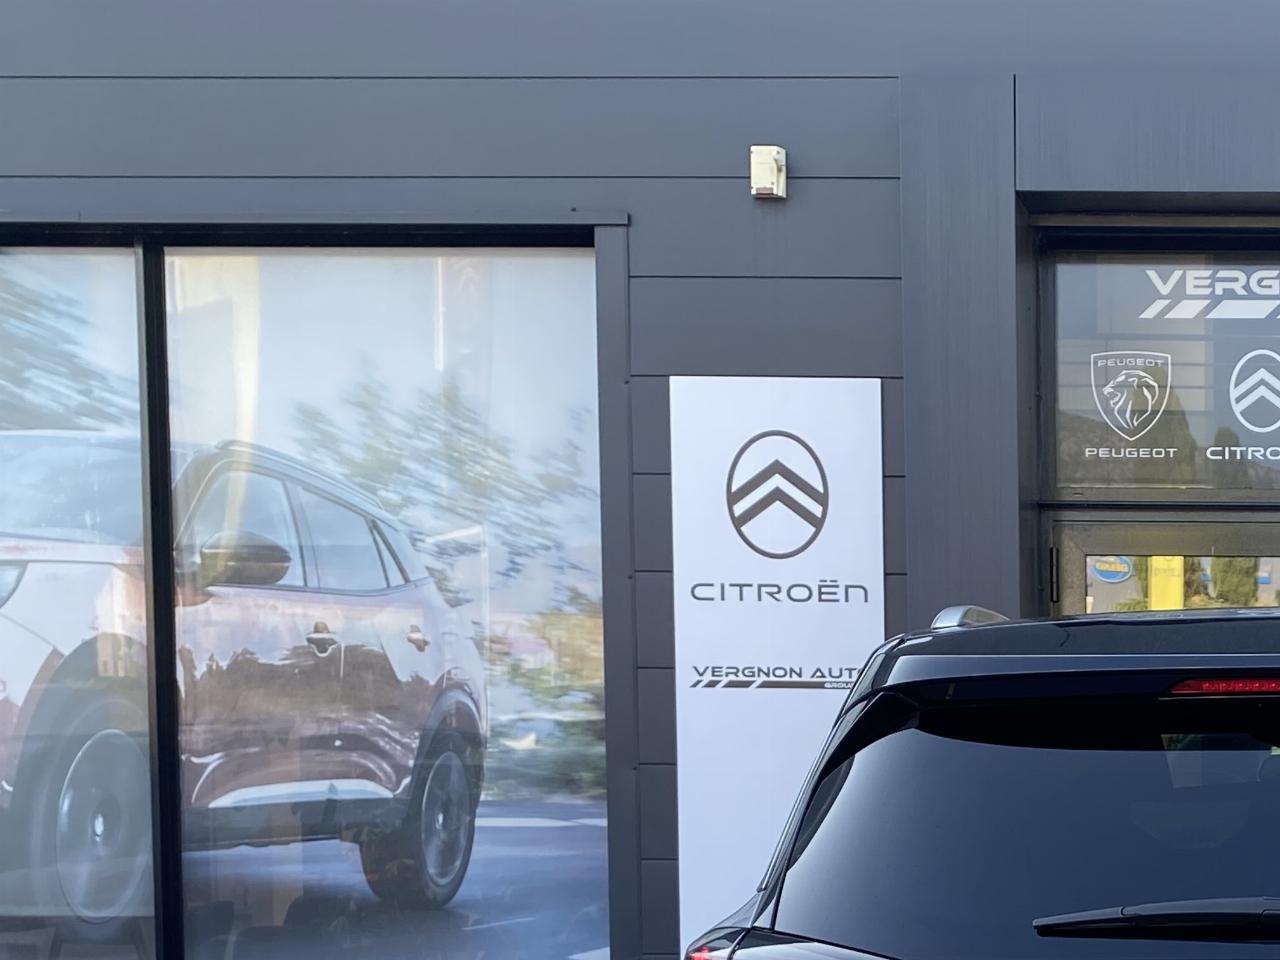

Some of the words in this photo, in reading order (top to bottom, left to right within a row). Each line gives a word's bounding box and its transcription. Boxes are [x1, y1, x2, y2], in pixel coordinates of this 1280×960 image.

[1097, 357, 1164, 368] PEUGEOT
[1085, 447, 1178, 459] PEUGEOT
[692, 665, 803, 679] VERGNON
